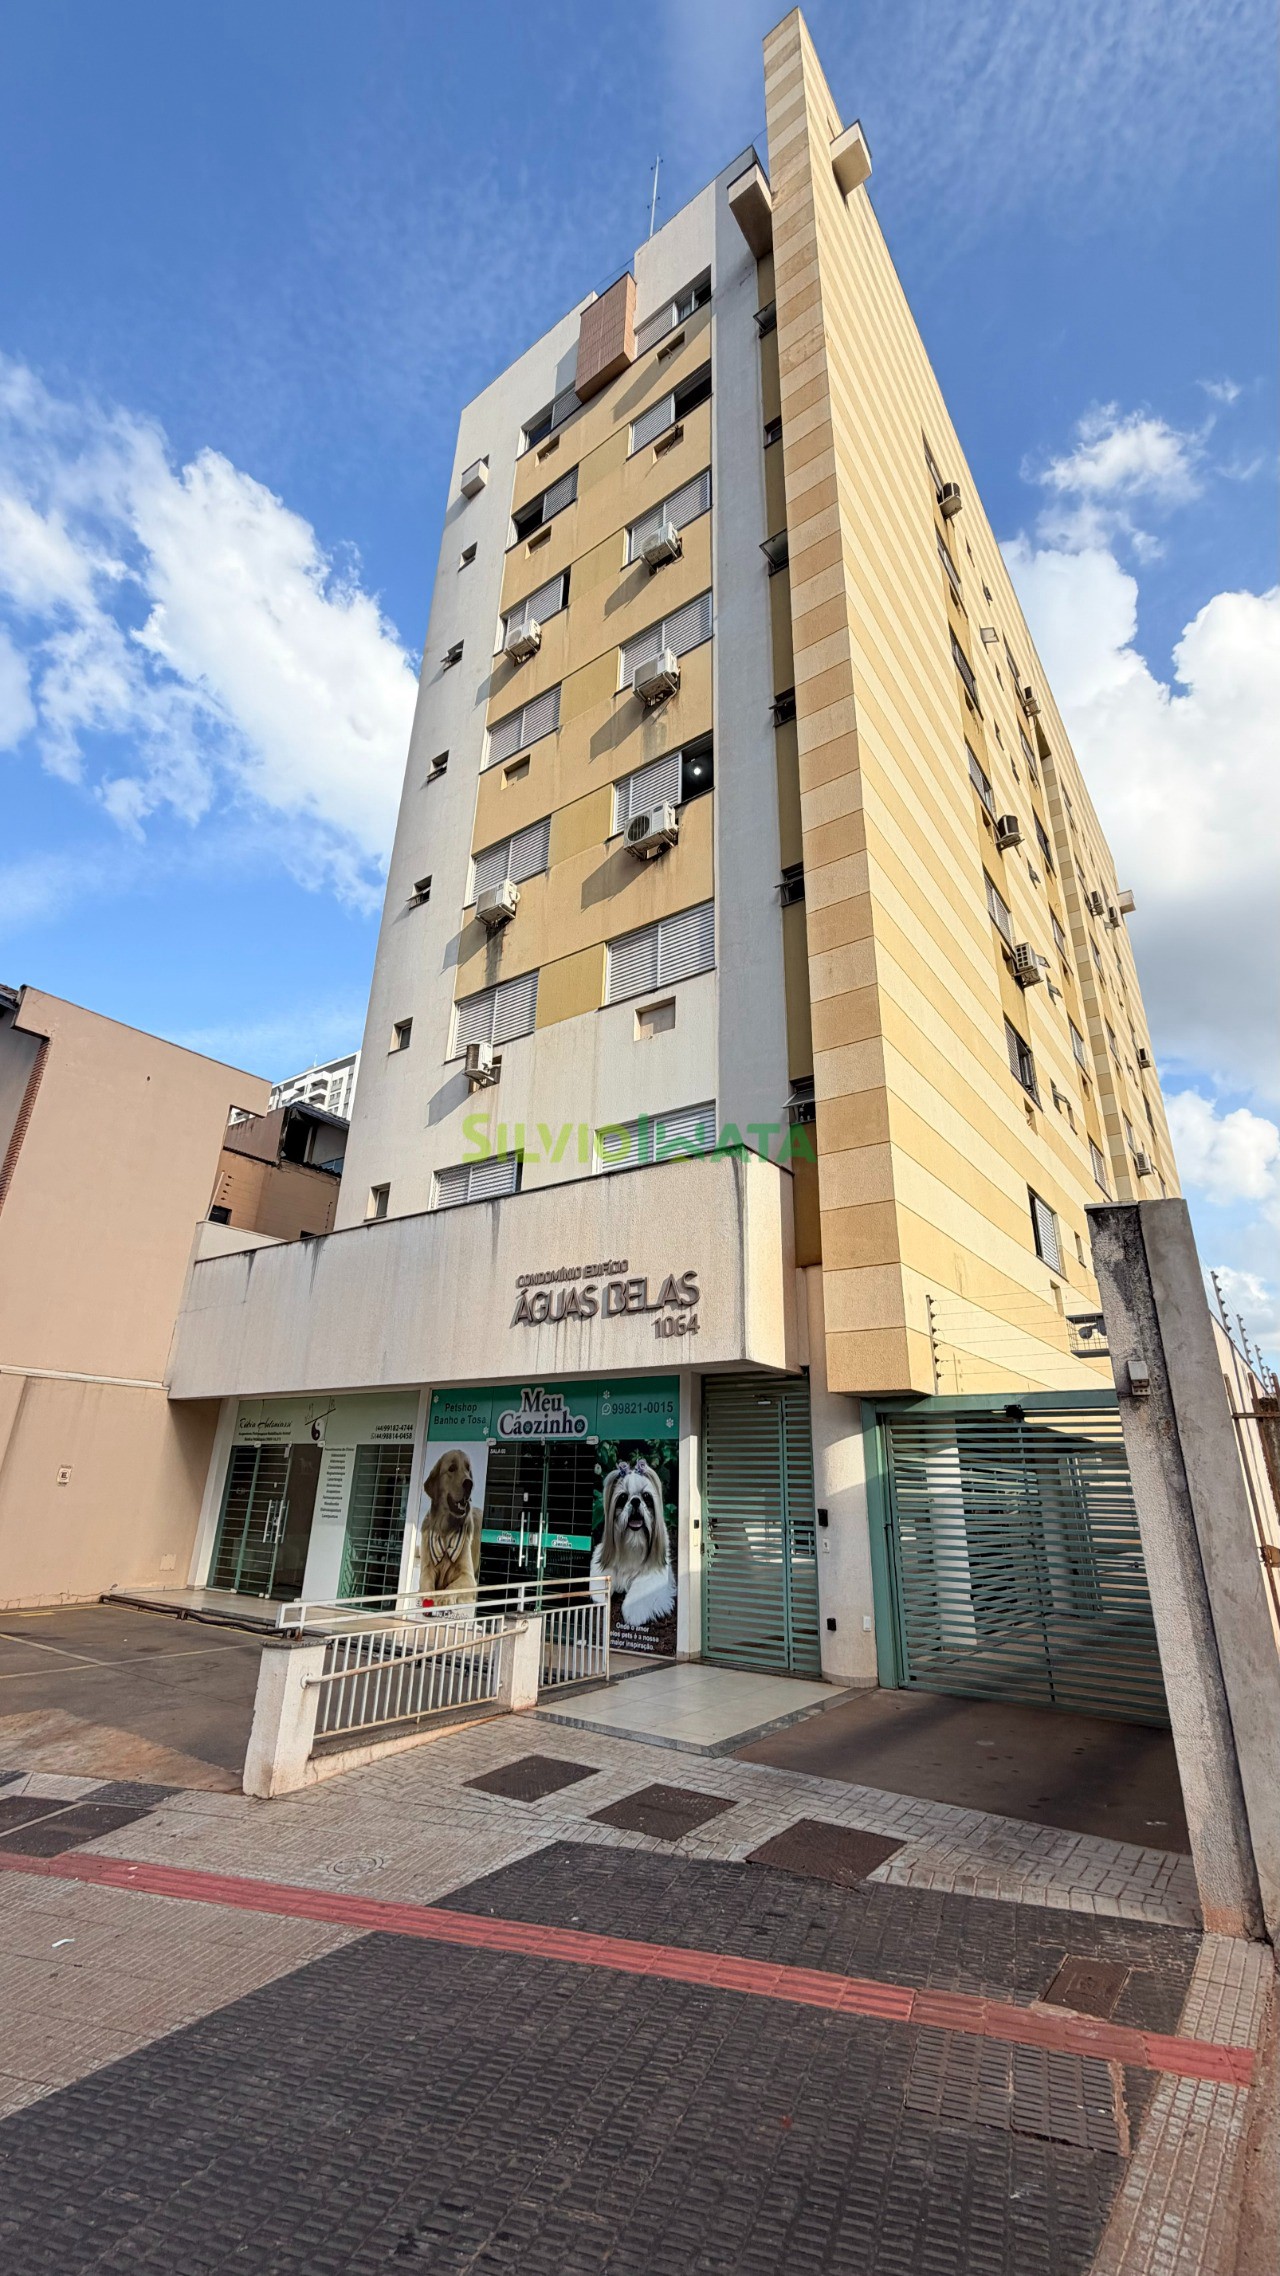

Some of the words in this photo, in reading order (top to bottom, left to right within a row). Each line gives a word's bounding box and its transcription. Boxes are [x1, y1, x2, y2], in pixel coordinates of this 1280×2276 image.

[583, 1259, 629, 1279] EDIFÍCIO
[512, 1285, 599, 1325] ÁGUAS
[606, 1270, 700, 1316] BELAS
[653, 1314, 700, 1338] 1064
[445, 1403, 478, 1413] Petshop
[521, 1390, 563, 1412] Meu
[611, 1401, 674, 1415] 99821-0015
[434, 1415, 459, 1425] Banho
[460, 1417, 466, 1425] e
[468, 1414, 487, 1425] Tosa
[499, 1411, 586, 1435] Cãozinho
[615, 1622, 630, 1630] Onde
